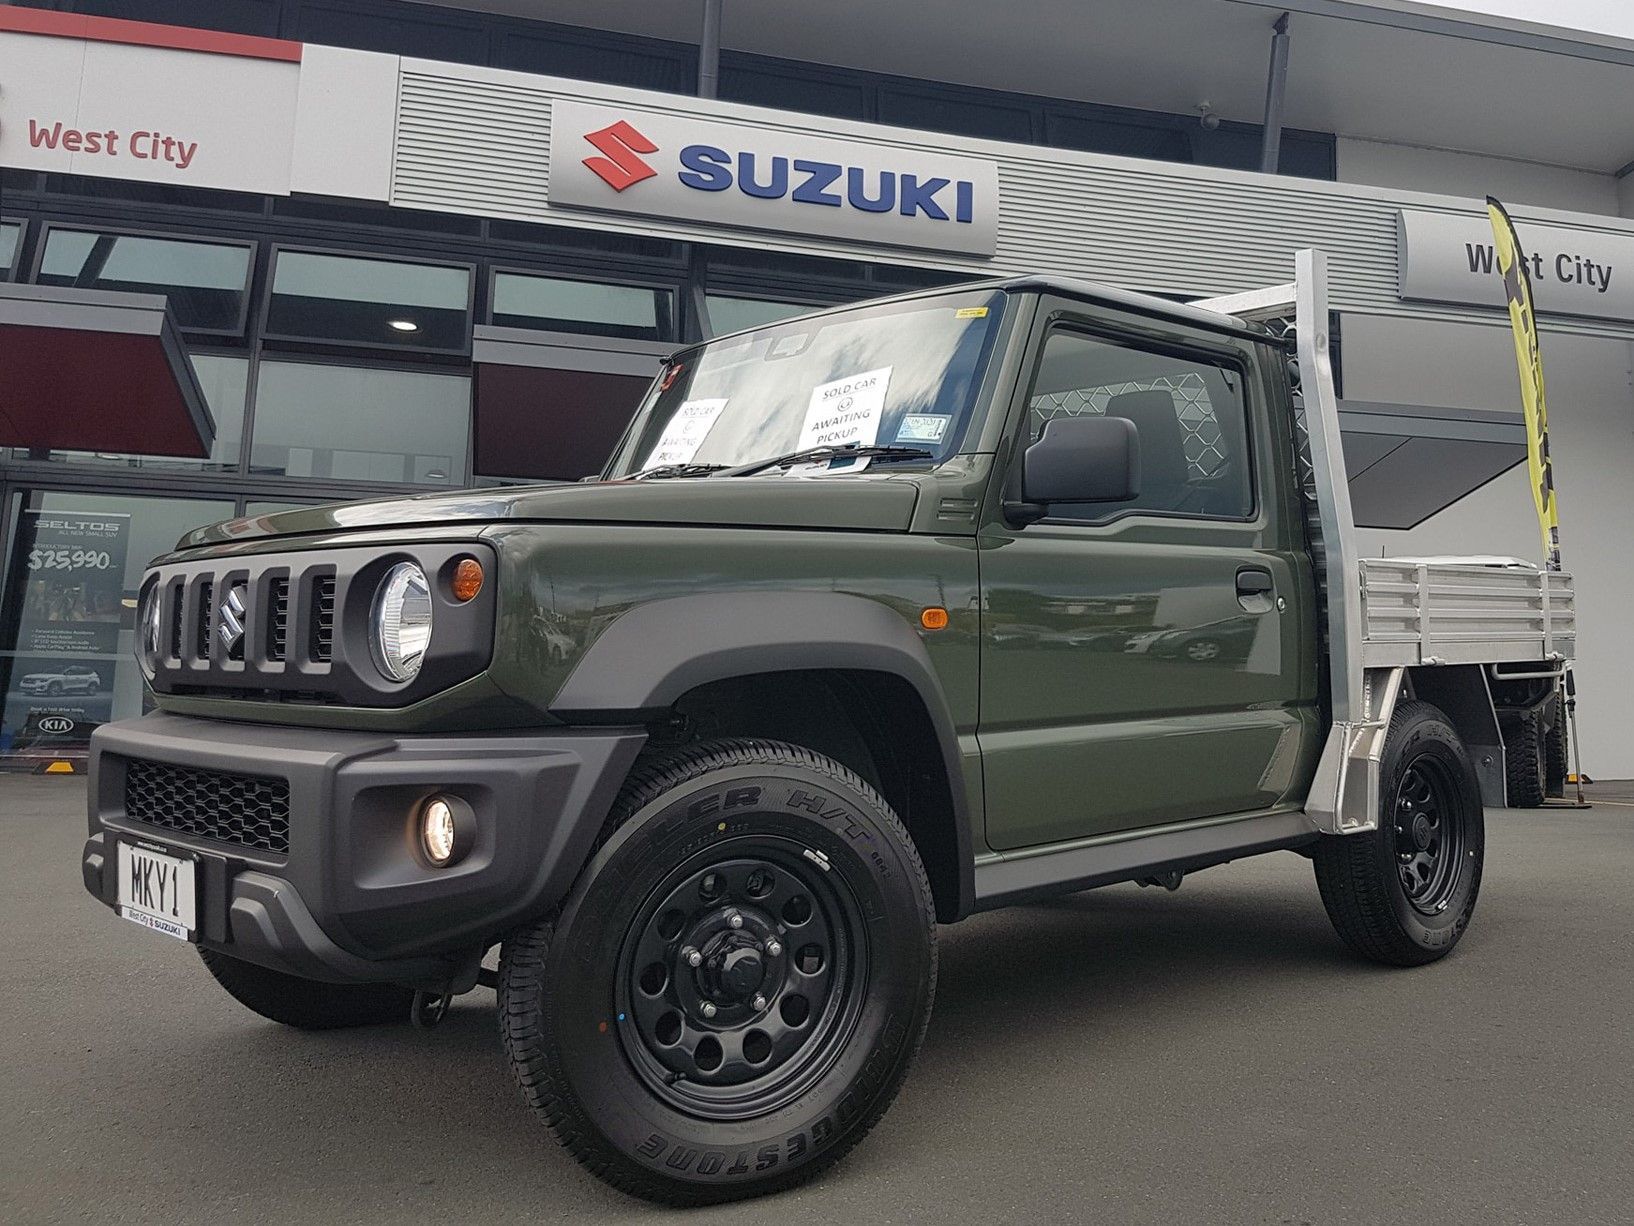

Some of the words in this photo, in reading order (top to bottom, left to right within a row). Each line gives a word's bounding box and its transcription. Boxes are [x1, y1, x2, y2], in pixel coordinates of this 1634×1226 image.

[29, 119, 119, 156] West
[129, 131, 198, 169] City
[678, 144, 973, 224] SUZUKI
[1465, 243, 1544, 280] Wst
[1555, 253, 1612, 293] City
[822, 384, 851, 400] SOLD
[854, 378, 877, 391] CAR
[811, 409, 871, 432] AWAITING
[817, 427, 859, 444] PICKUP
[34, 520, 121, 532] SELTOS
[28, 549, 111, 572] $25,990
[44, 720, 68, 730] KIA
[787, 789, 874, 843] H/T
[131, 854, 179, 917] MKY1
[154, 919, 181, 935] SUZUKI
